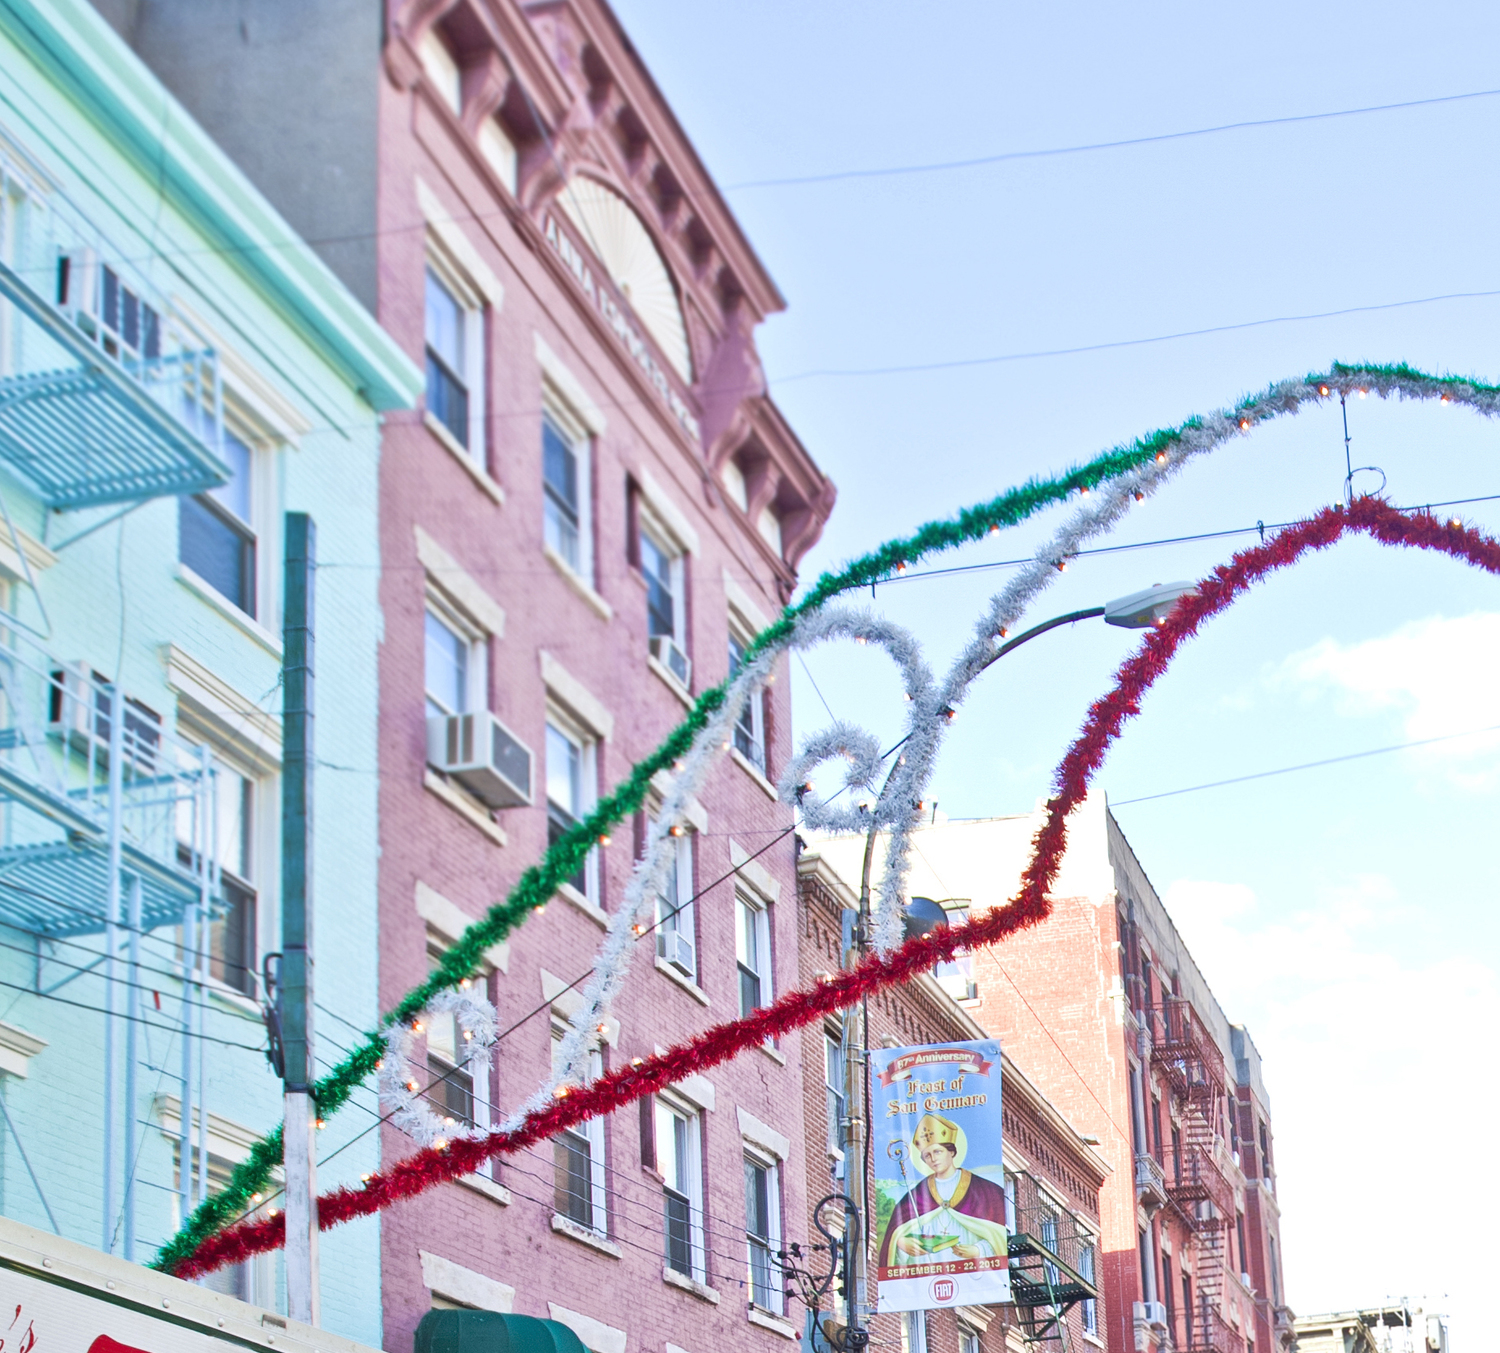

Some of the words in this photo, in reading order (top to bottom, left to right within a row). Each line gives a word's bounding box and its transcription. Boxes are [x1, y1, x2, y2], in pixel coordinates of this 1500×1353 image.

[915, 1052, 976, 1064] Anniversary
[907, 1081, 946, 1098] Feast
[950, 1075, 964, 1093] of
[886, 1099, 918, 1119] San
[924, 1093, 988, 1112] Gennaro
[887, 1265, 942, 1278] SEPTEMBER
[945, 1264, 956, 1272] 12
[963, 1262, 977, 1271] 22,
[979, 1259, 1001, 1269] 2013
[935, 1282, 952, 1298] FIAT
